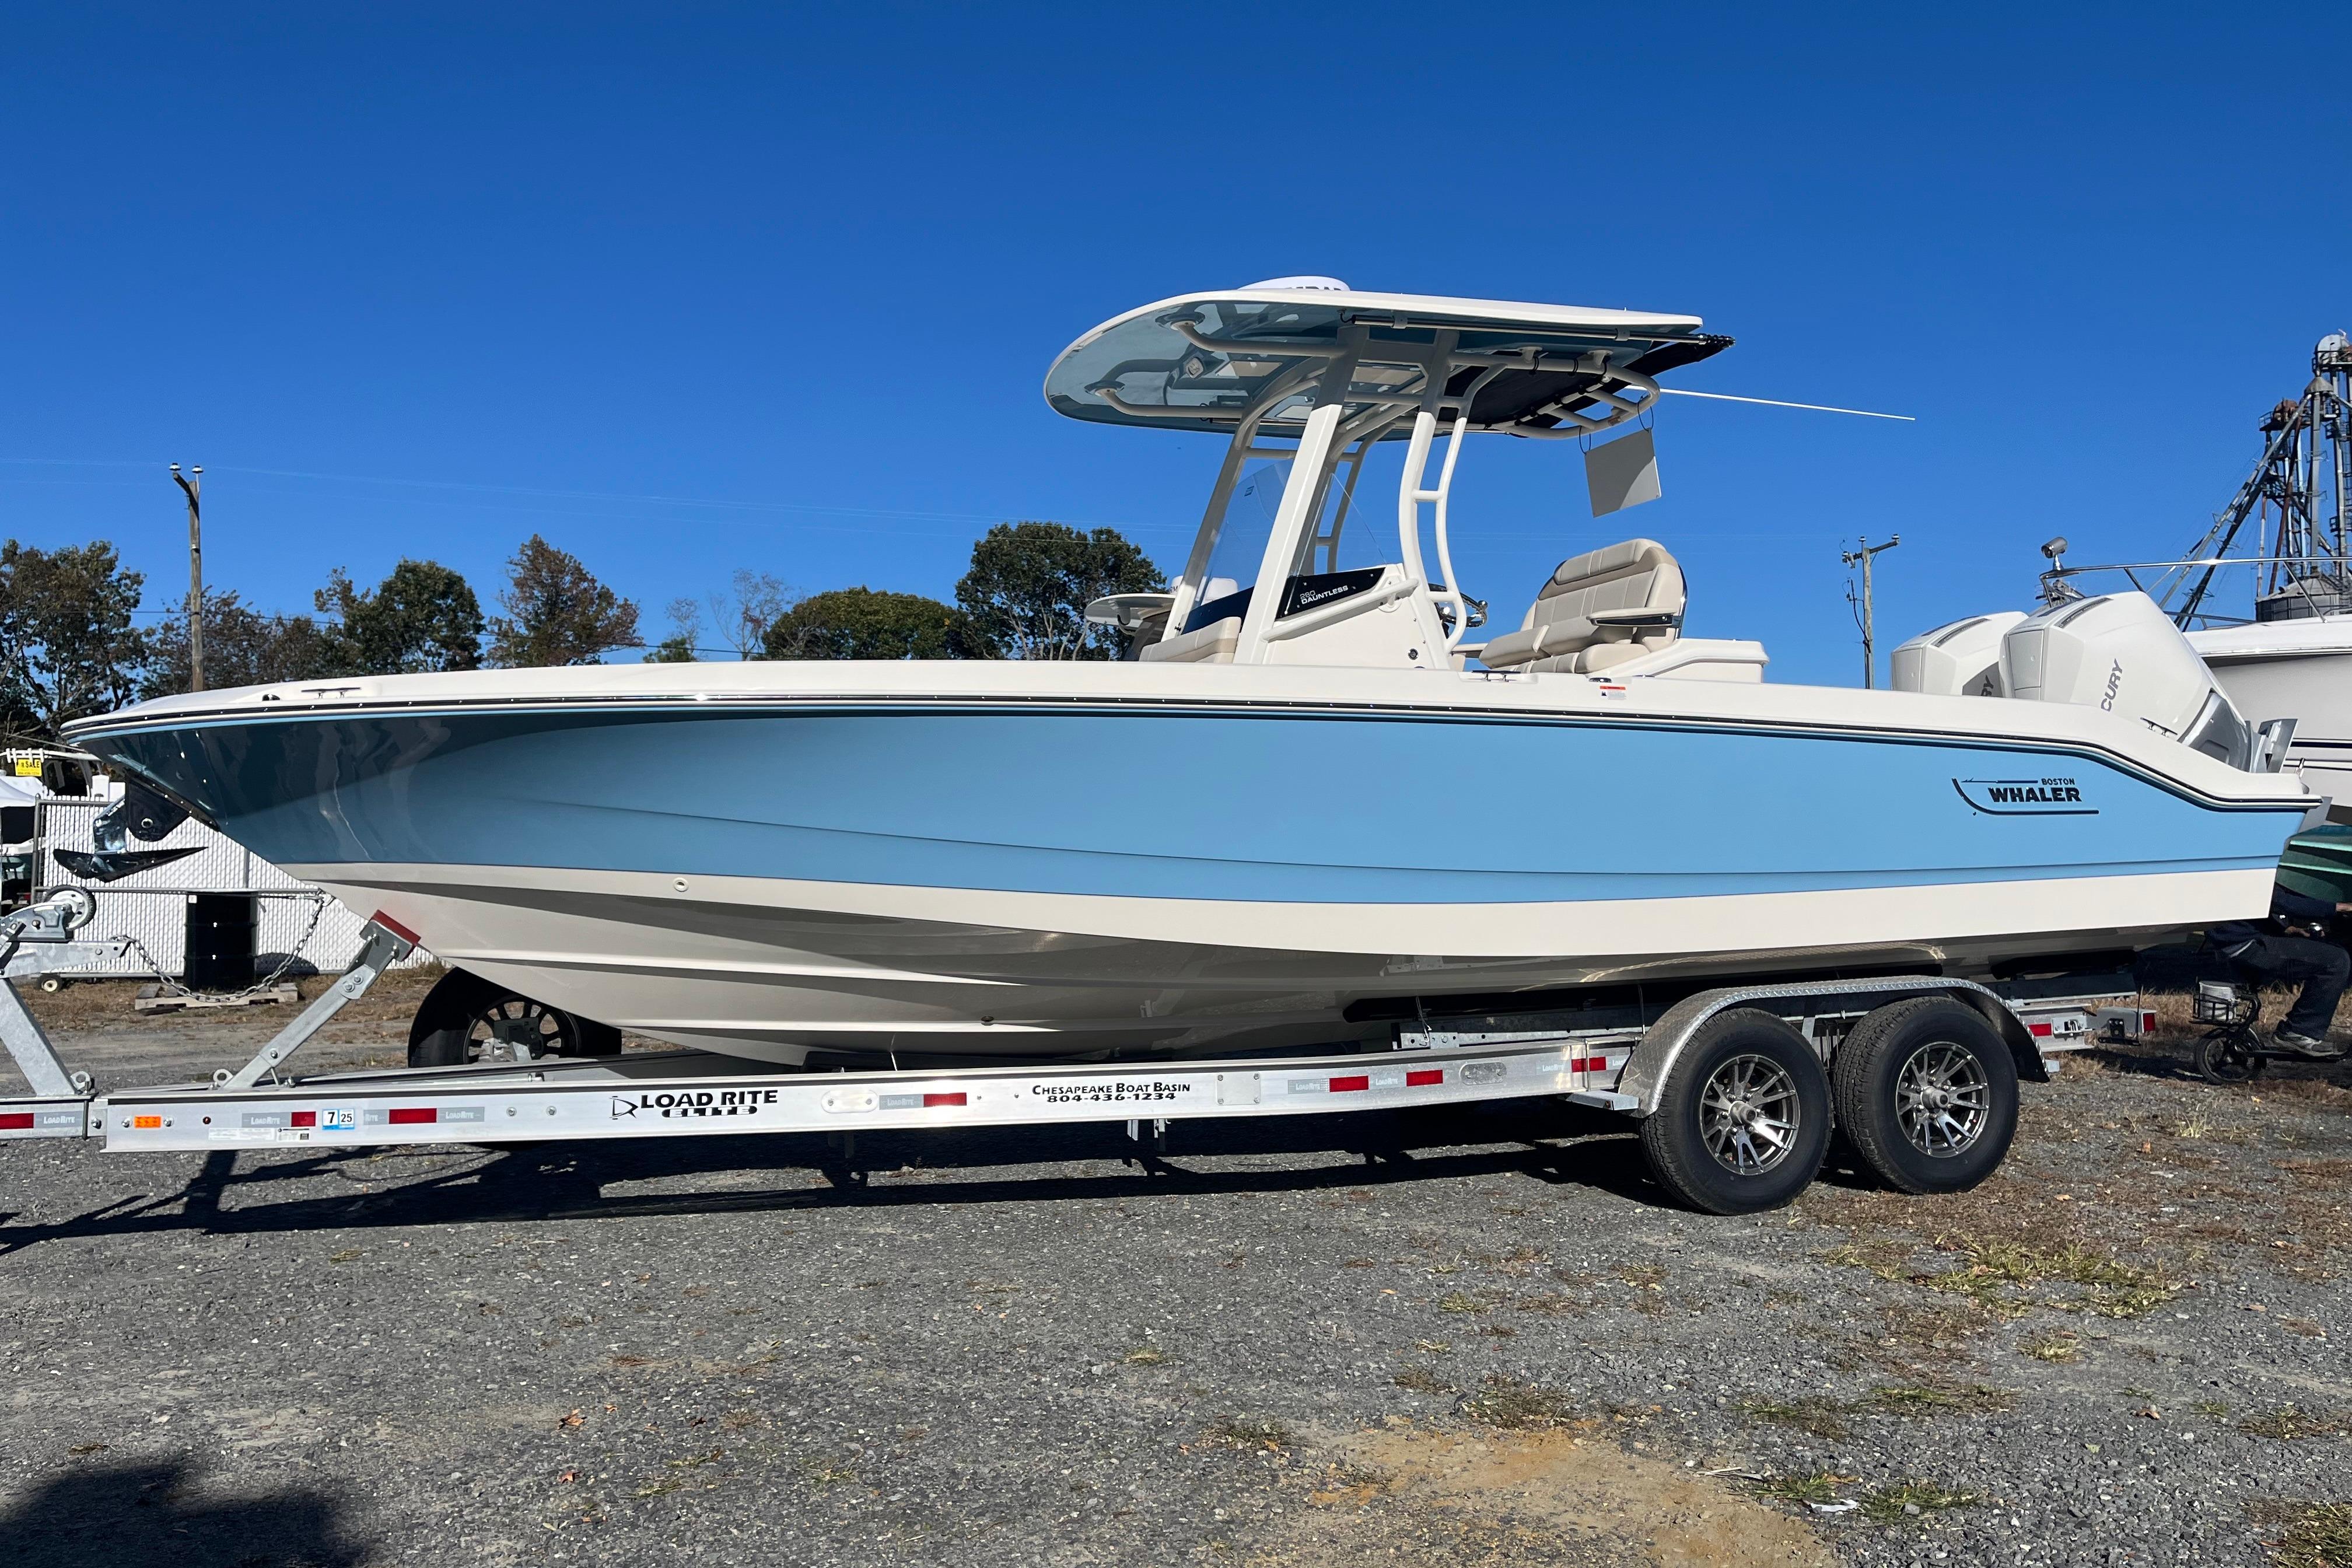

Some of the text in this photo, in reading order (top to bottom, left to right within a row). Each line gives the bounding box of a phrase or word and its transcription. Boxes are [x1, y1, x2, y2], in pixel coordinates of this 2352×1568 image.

[1300, 590, 1316, 600] 280
[1301, 585, 1349, 604] DAUNTLESS
[2041, 778, 2076, 786] BOSTON
[1987, 787, 2082, 803] WHALER
[1032, 1082, 1191, 1095] CHESAPEAKE BOAT BASIN
[640, 1090, 778, 1108] LOAD RITE
[1047, 1093, 1176, 1102] 804-436-1234
[328, 1111, 335, 1124] 7
[341, 1113, 352, 1123] 25
[669, 1106, 751, 1118] ELITE
